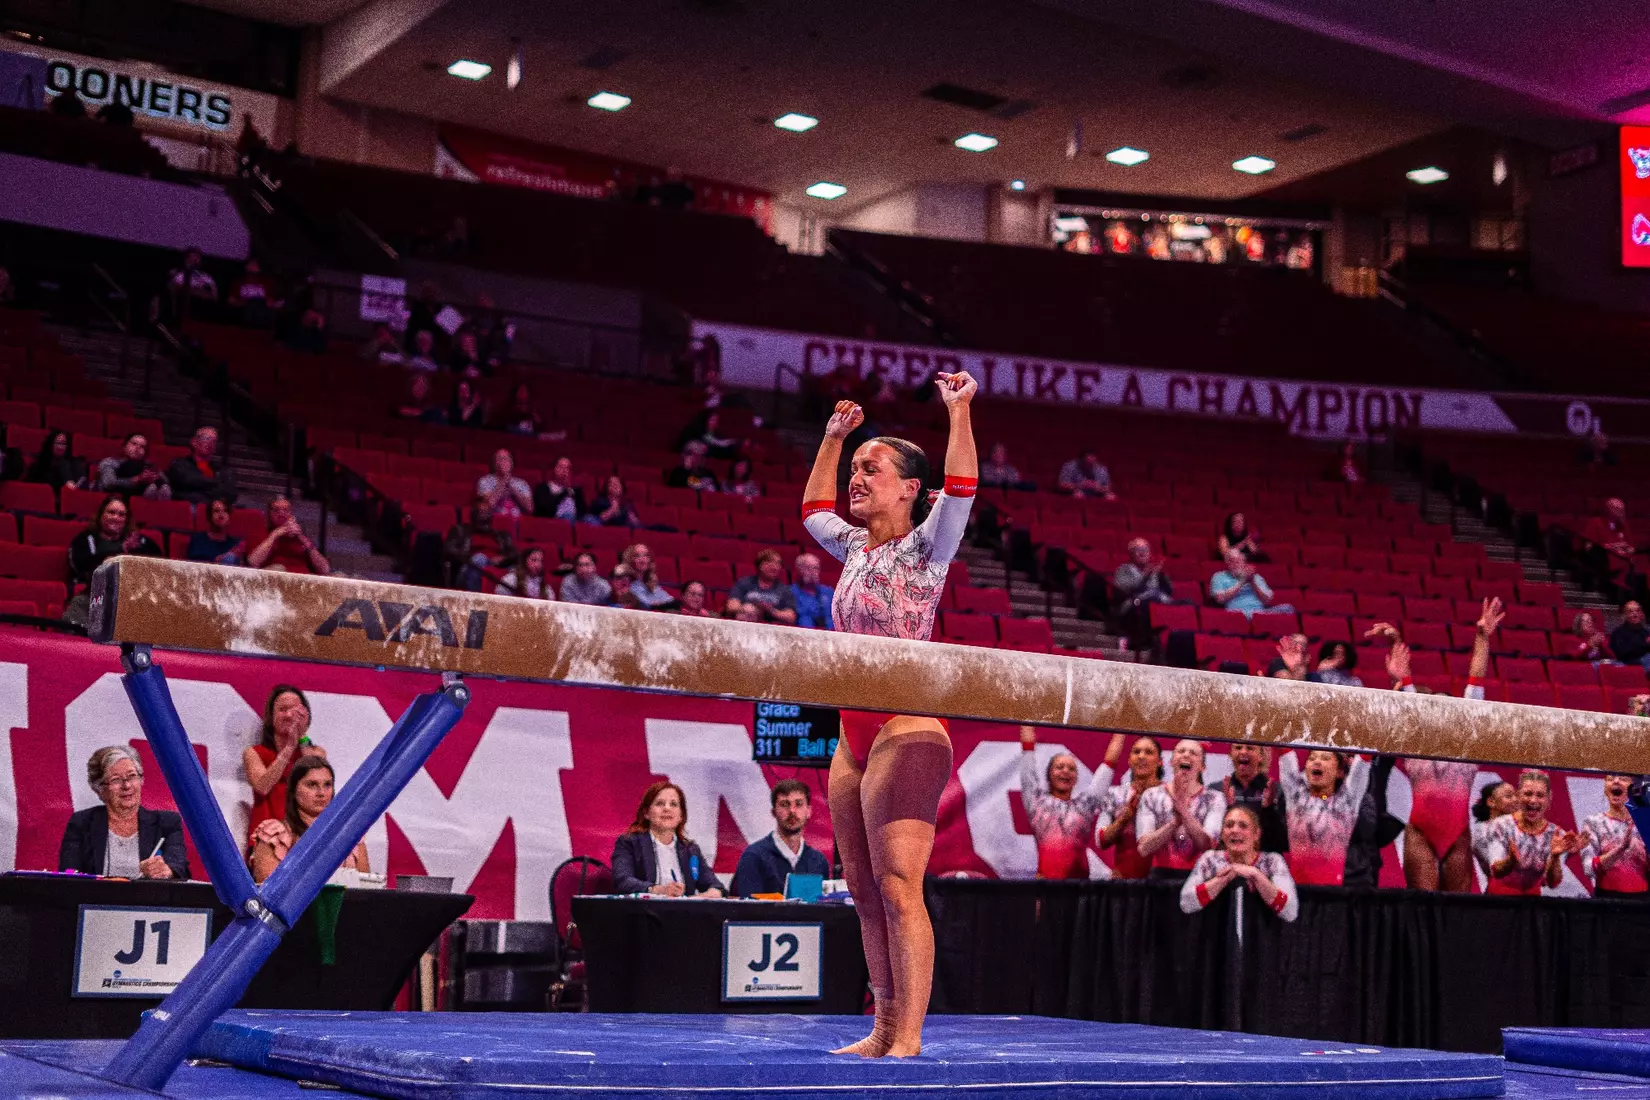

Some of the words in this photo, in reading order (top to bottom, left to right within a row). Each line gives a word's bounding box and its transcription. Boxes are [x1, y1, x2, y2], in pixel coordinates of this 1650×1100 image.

[980, 359, 1102, 403] LIKE
[1120, 370, 1144, 408] A
[1166, 376, 1423, 434] CHAMPION
[757, 701, 801, 718] Grace
[756, 718, 812, 737] Sumner
[756, 738, 781, 756] 311
[797, 738, 826, 757] Ball
[114, 919, 171, 965] J1
[748, 933, 799, 972] J2
